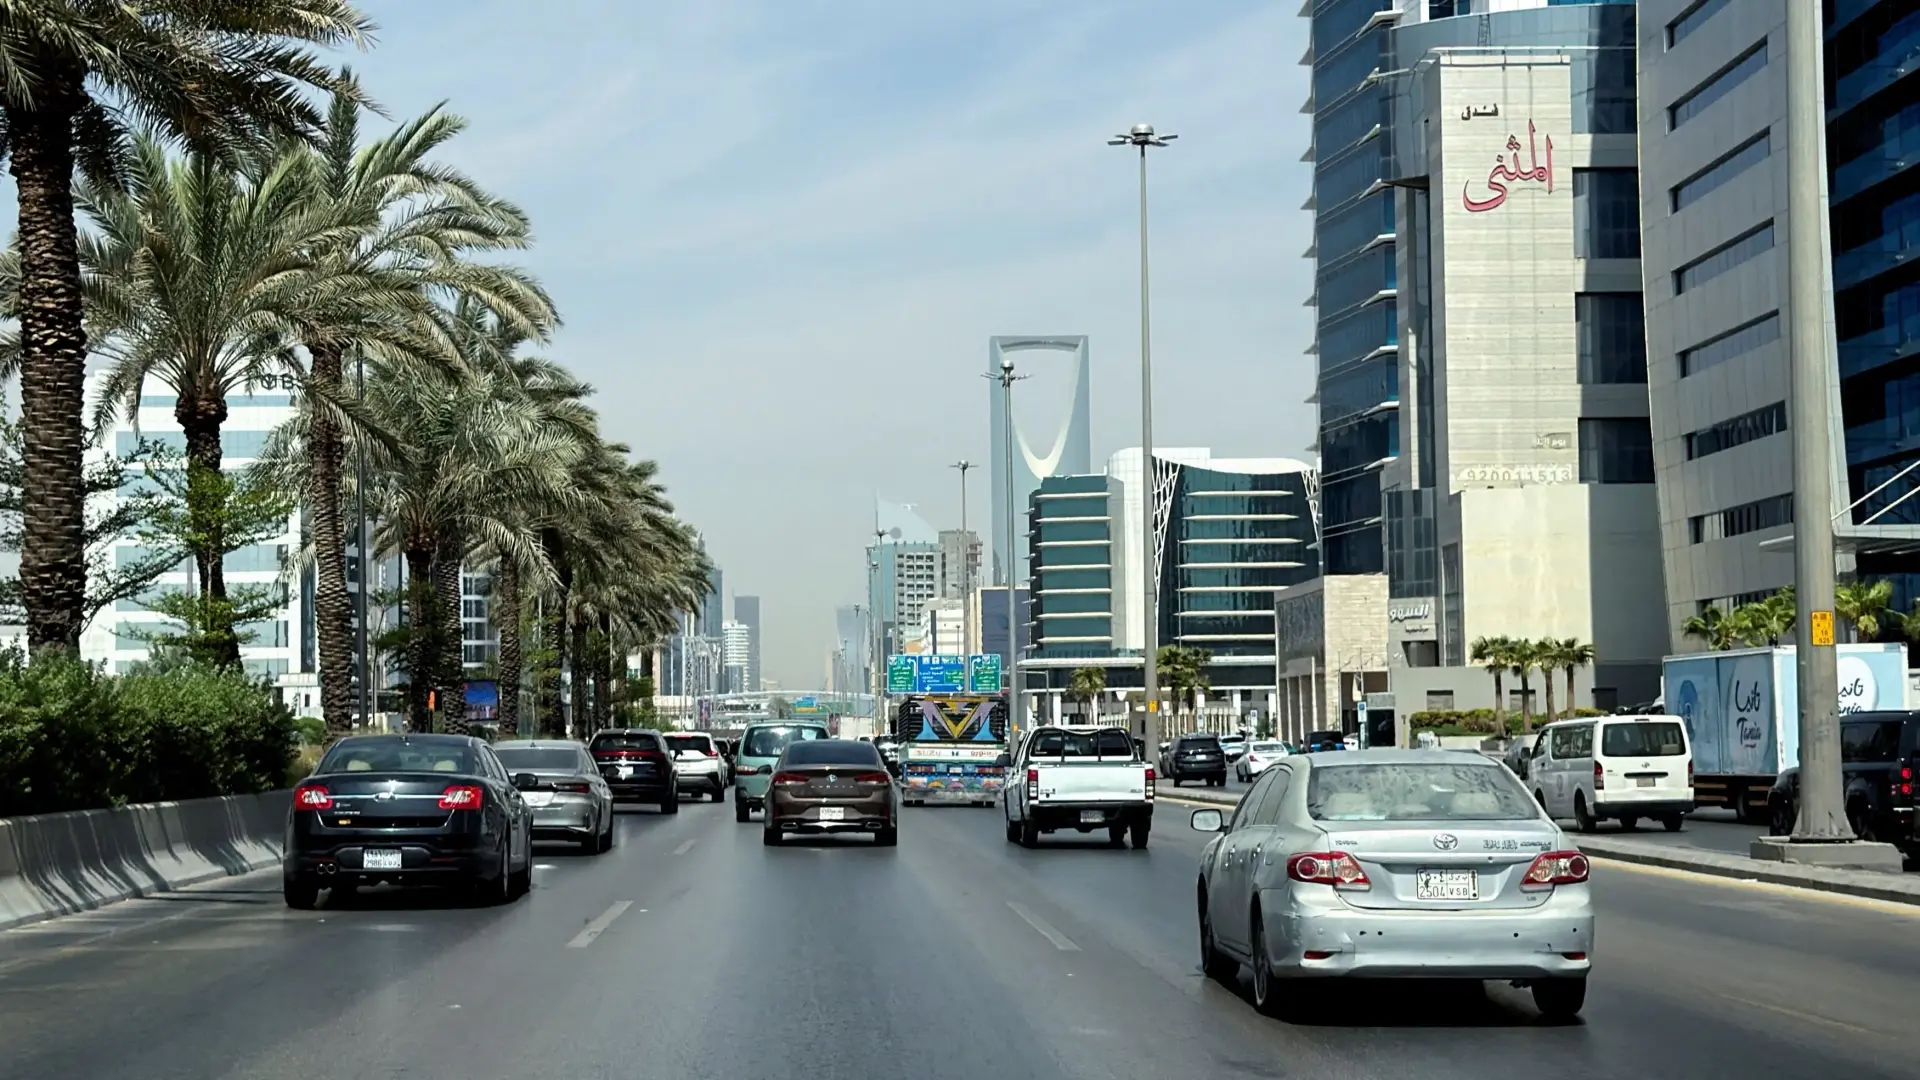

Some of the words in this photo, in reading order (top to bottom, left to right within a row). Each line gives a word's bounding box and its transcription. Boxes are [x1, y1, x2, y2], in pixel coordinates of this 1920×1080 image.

[1461, 103, 1499, 120] فندق
[1463, 118, 1553, 212] المثنى
[1467, 470, 1570, 481] 920011513
[1735, 680, 1760, 712] تانيا
[1838, 678, 1864, 697] تاني
[1736, 717, 1761, 745] Tania
[1419, 886, 1445, 897] 2504
